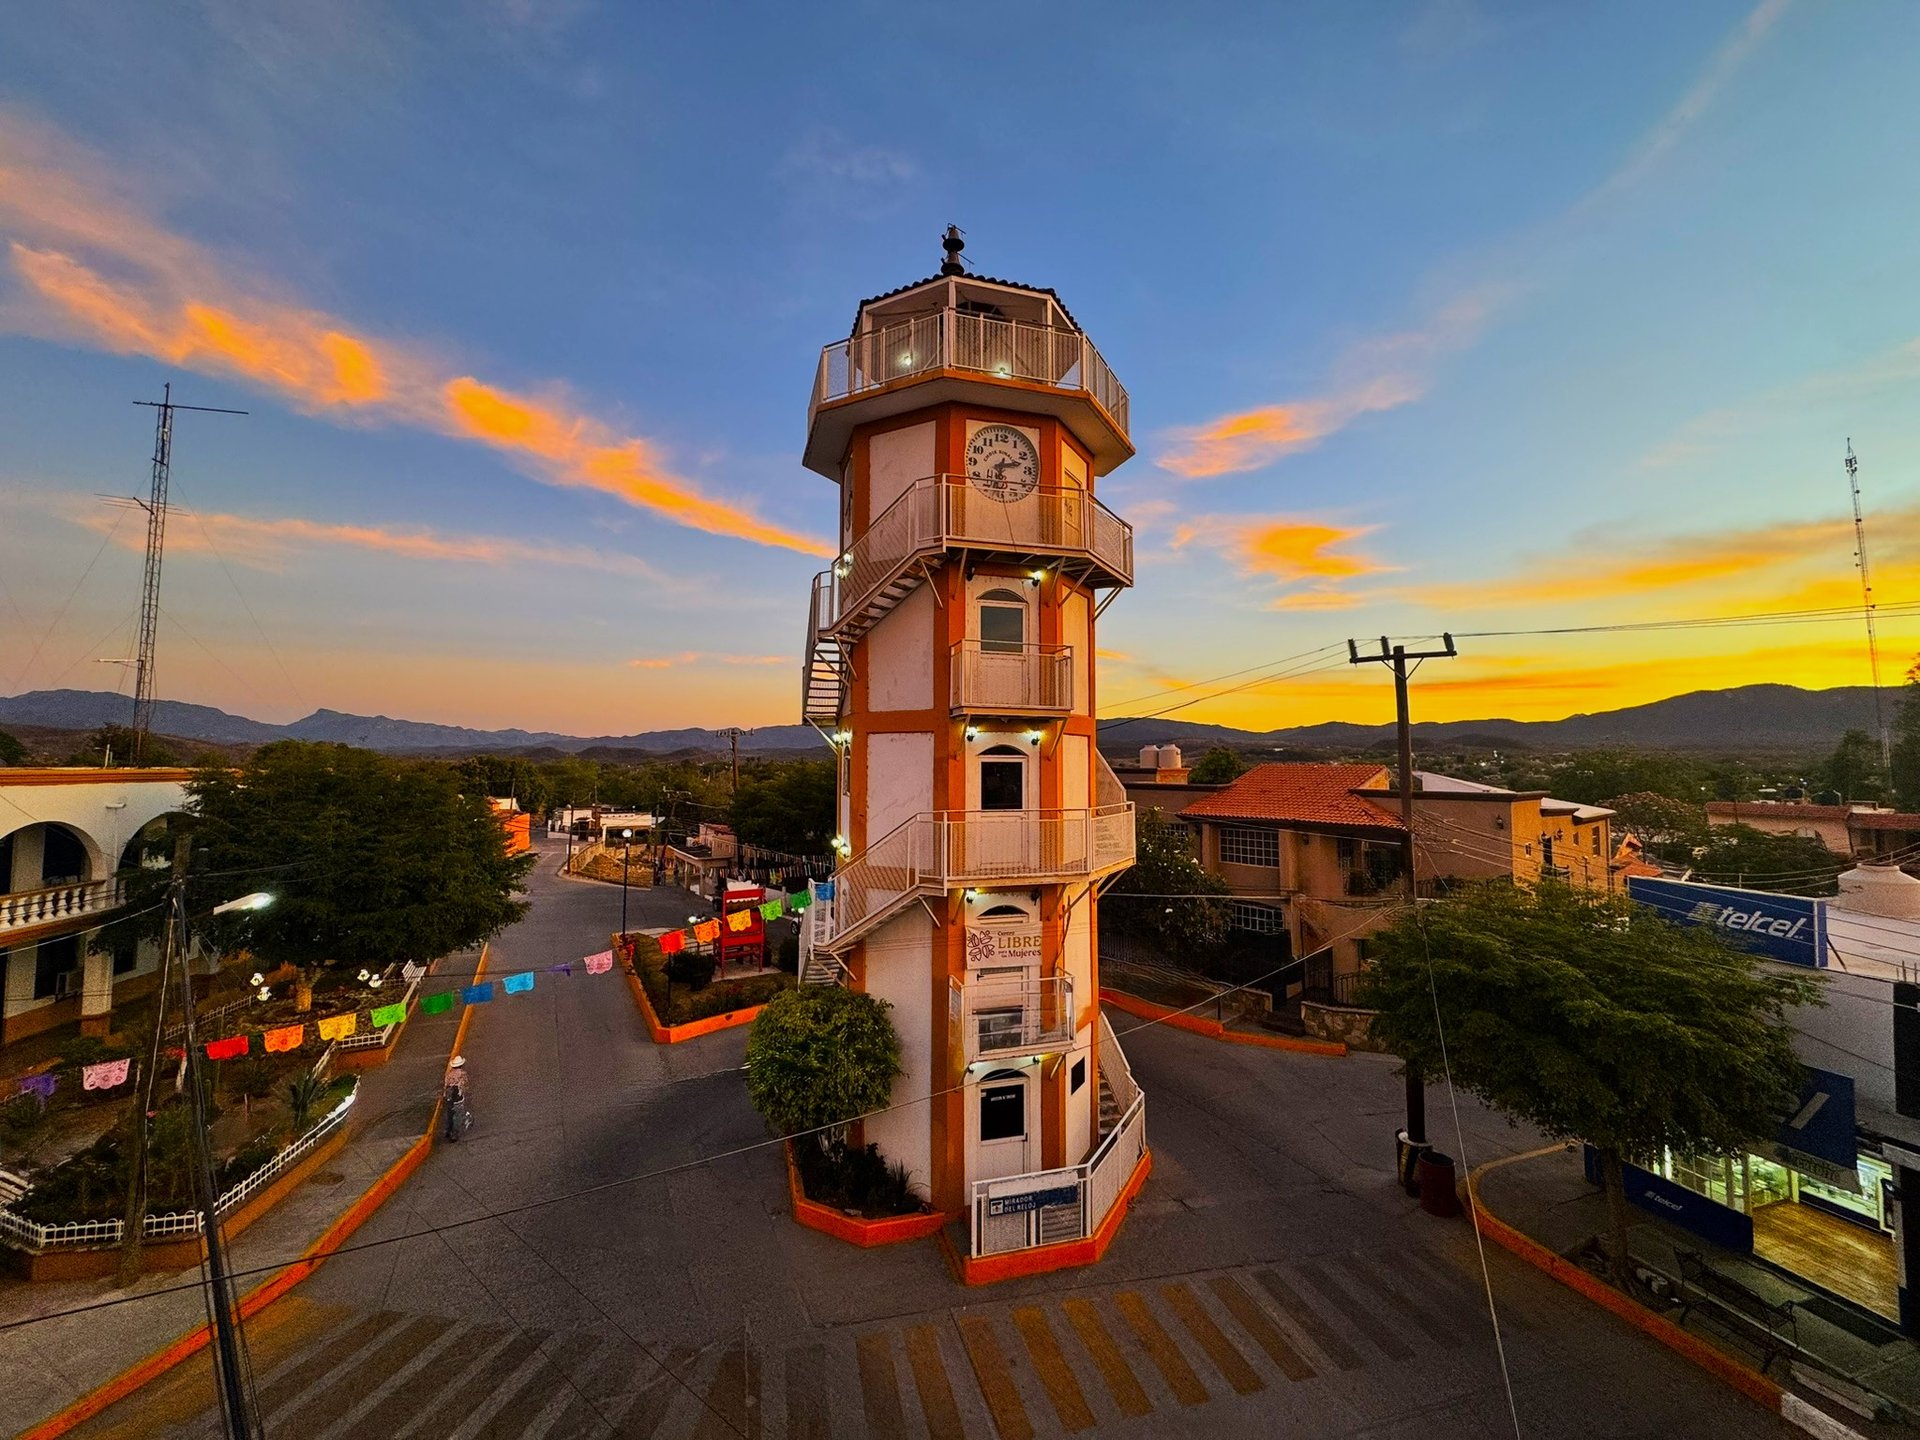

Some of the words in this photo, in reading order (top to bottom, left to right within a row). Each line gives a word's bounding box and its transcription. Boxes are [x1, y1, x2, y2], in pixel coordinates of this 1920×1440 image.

[983, 438, 993, 447] 11
[994, 433, 1009, 443] 12
[1012, 440, 1018, 449] 1
[972, 445, 984, 455] 10
[1019, 451, 1028, 461] 2
[968, 457, 978, 466] 9
[1023, 466, 1032, 475] 3
[1715, 906, 1807, 939] telcel
[998, 936, 1042, 949] LIBRE
[1008, 949, 1042, 958] Mujeres
[1004, 1195, 1033, 1205] MIRADOR
[1017, 1202, 1036, 1211] RELOJ
